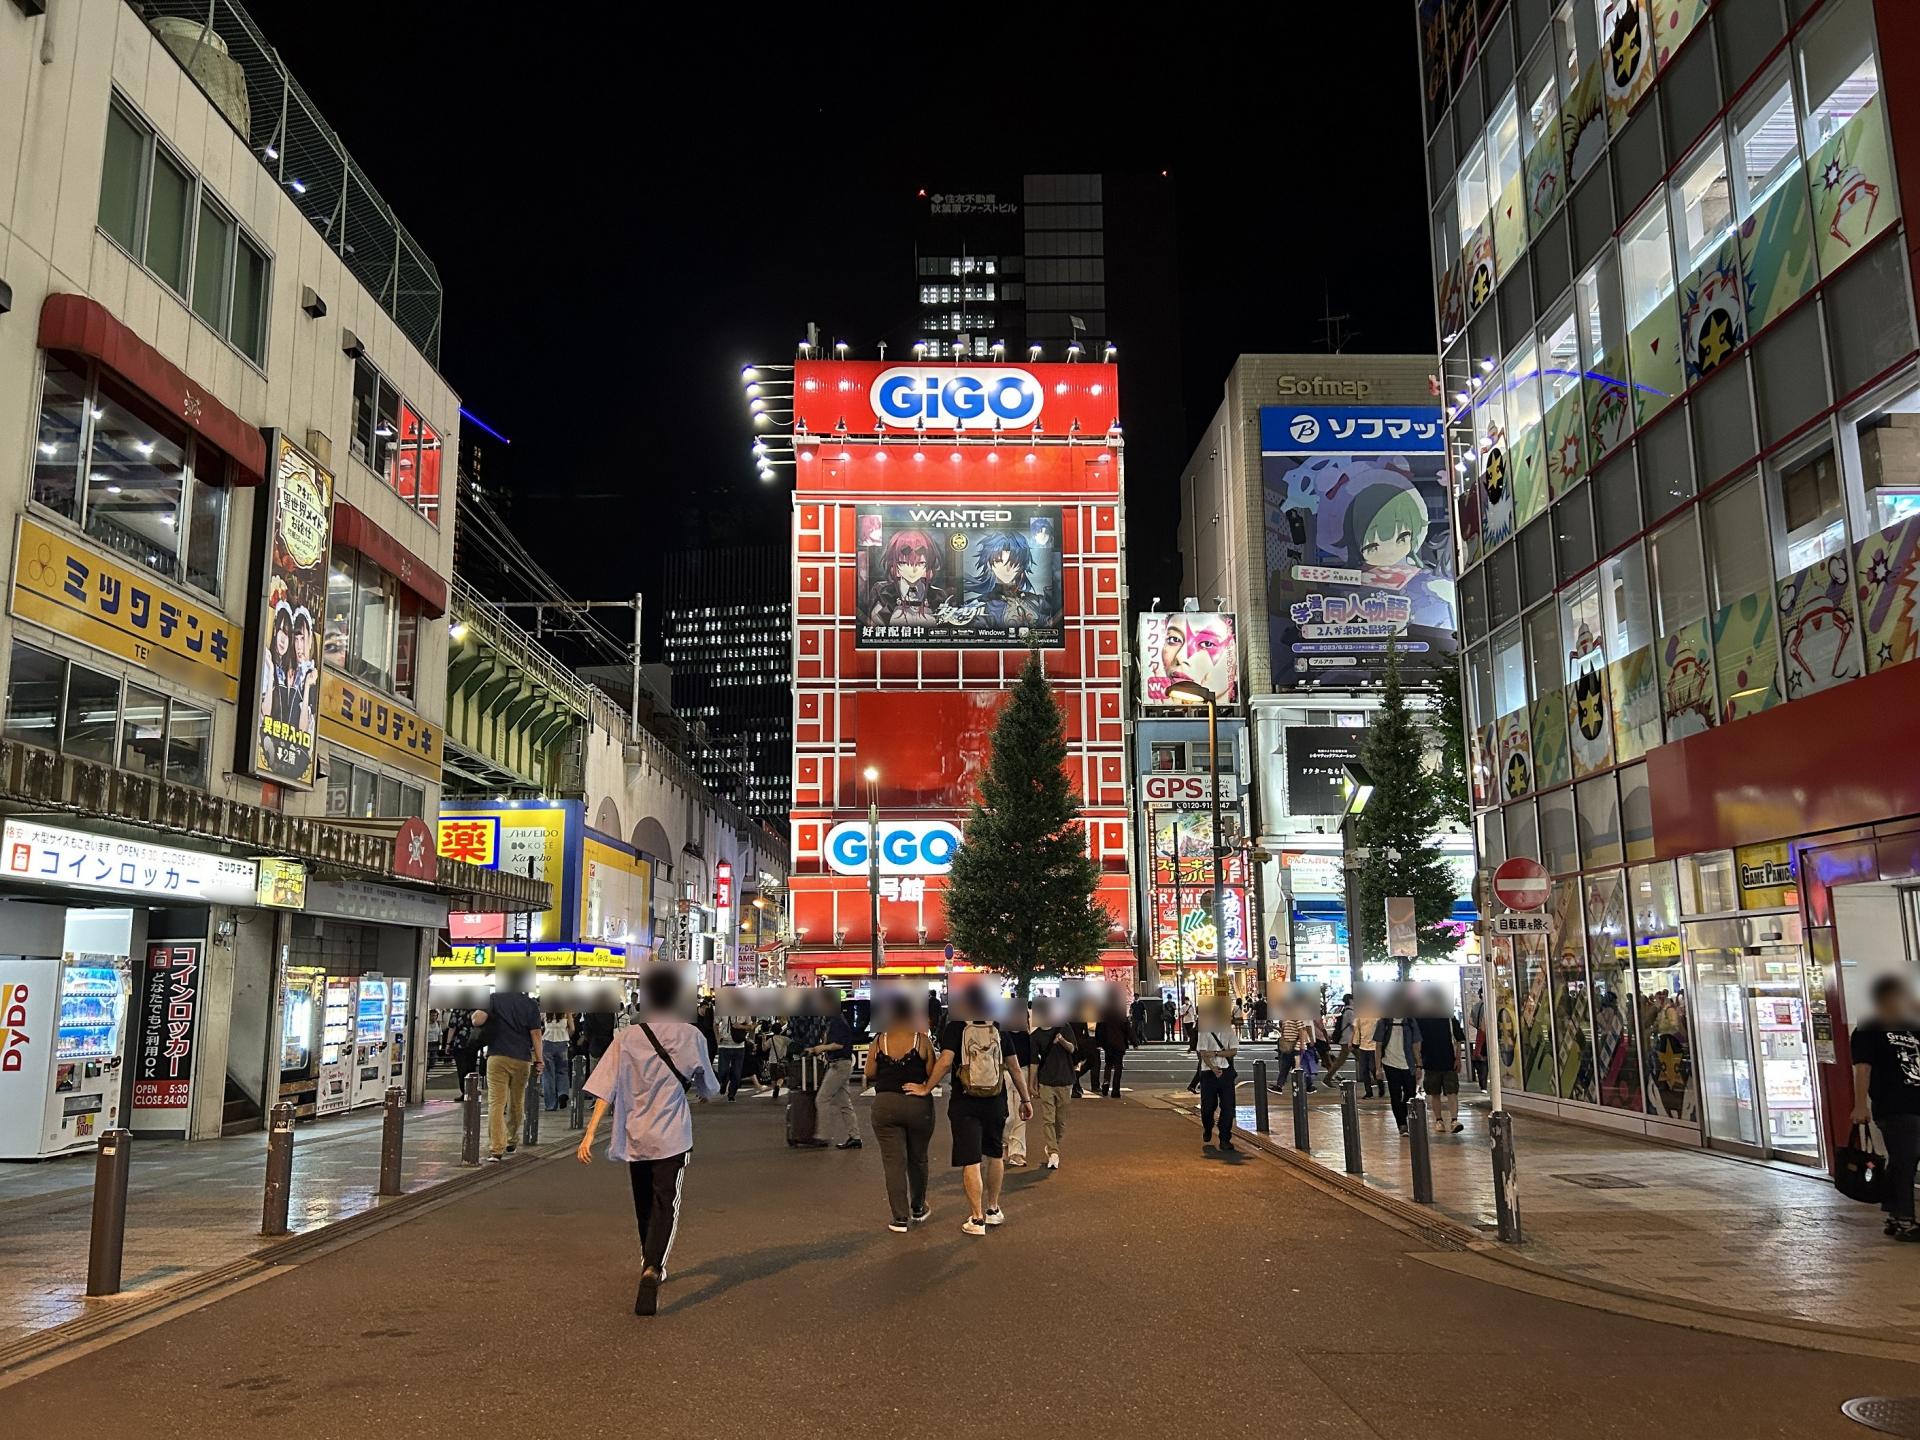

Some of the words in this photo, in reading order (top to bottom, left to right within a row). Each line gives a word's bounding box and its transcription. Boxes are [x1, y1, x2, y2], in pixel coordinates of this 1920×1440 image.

[878, 375, 1036, 420] GiGO
[1278, 375, 1370, 400] Sofmap
[1328, 418, 1445, 440] ソフマッ
[908, 509, 1012, 522] WANTED
[64, 555, 229, 664] ミツワデンキ
[862, 625, 925, 638] 好評配信中
[1147, 618, 1160, 675] ワクワク
[341, 686, 432, 756] ミツワデンキ
[1146, 777, 1204, 799] GPS
[1205, 789, 1230, 798] nxt
[441, 822, 488, 863] 薬
[505, 829, 559, 838] SHISEIDO
[511, 852, 552, 862] Kaebo
[832, 829, 961, 866] GGO
[40, 850, 200, 890] コインロッカー
[217, 860, 254, 875] ミツワデンキ
[1742, 865, 1765, 886] GAME
[1765, 862, 1790, 883] PANIC
[1160, 892, 1202, 905] RAME
[1499, 918, 1549, 931] 自転車を除く
[163, 947, 198, 1078] コインロッカー
[2, 984, 30, 1072] DyDo
[144, 971, 166, 1078] どなたでもご利用OK
[134, 1095, 162, 1105] CLOSE
[163, 1095, 188, 1105] 24:00
[135, 1084, 158, 1094] OPEN
[169, 1084, 188, 1094] 5:30
